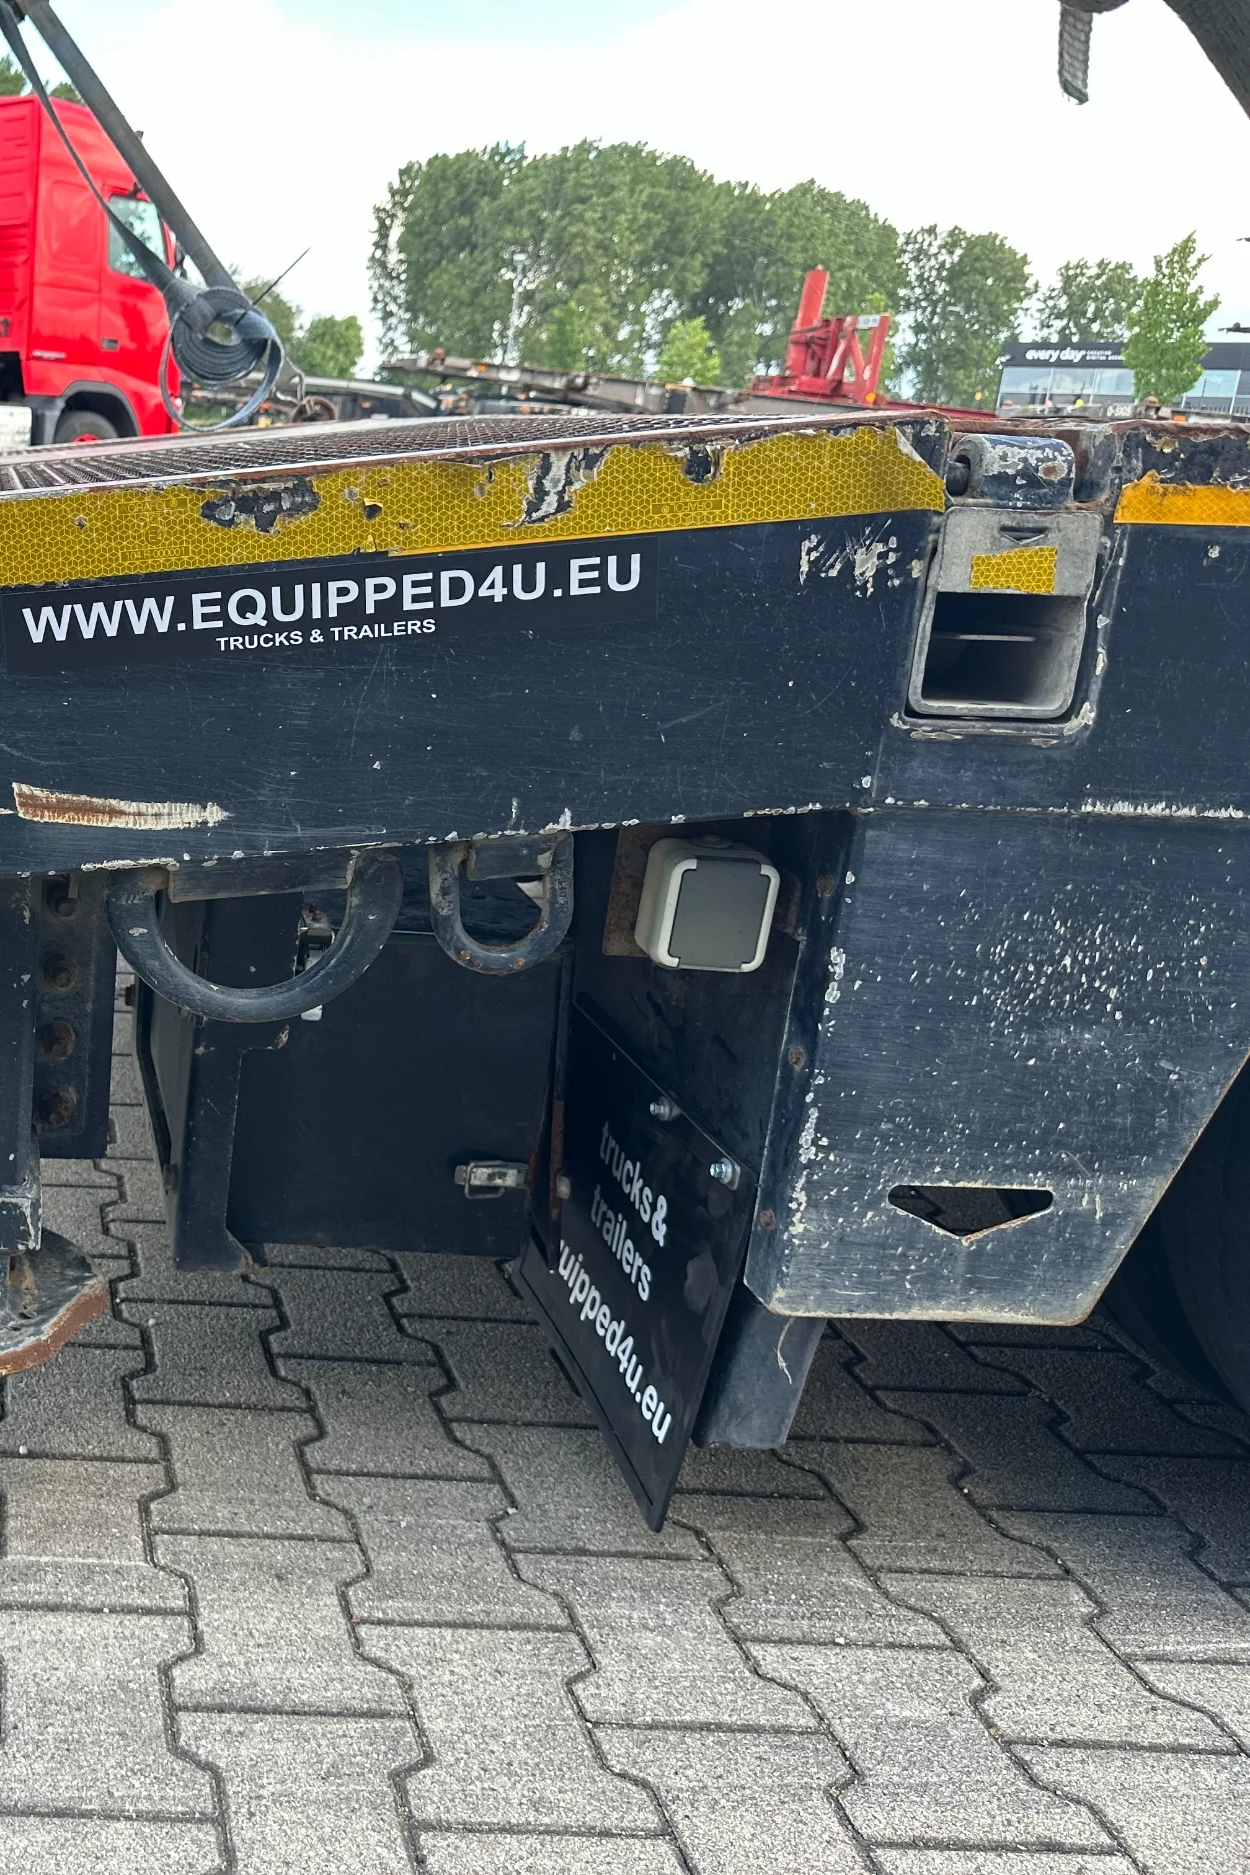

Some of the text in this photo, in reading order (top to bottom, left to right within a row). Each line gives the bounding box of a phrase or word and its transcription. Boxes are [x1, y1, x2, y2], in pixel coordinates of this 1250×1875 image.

[1025, 349, 1059, 363] every
[21, 553, 641, 644] WWW.EQUIPPED4U.EU
[216, 618, 436, 651] TRUCKS & TRAILERS
[591, 1184, 652, 1302] trailers
[558, 1239, 672, 1445] uipped4u.eu
